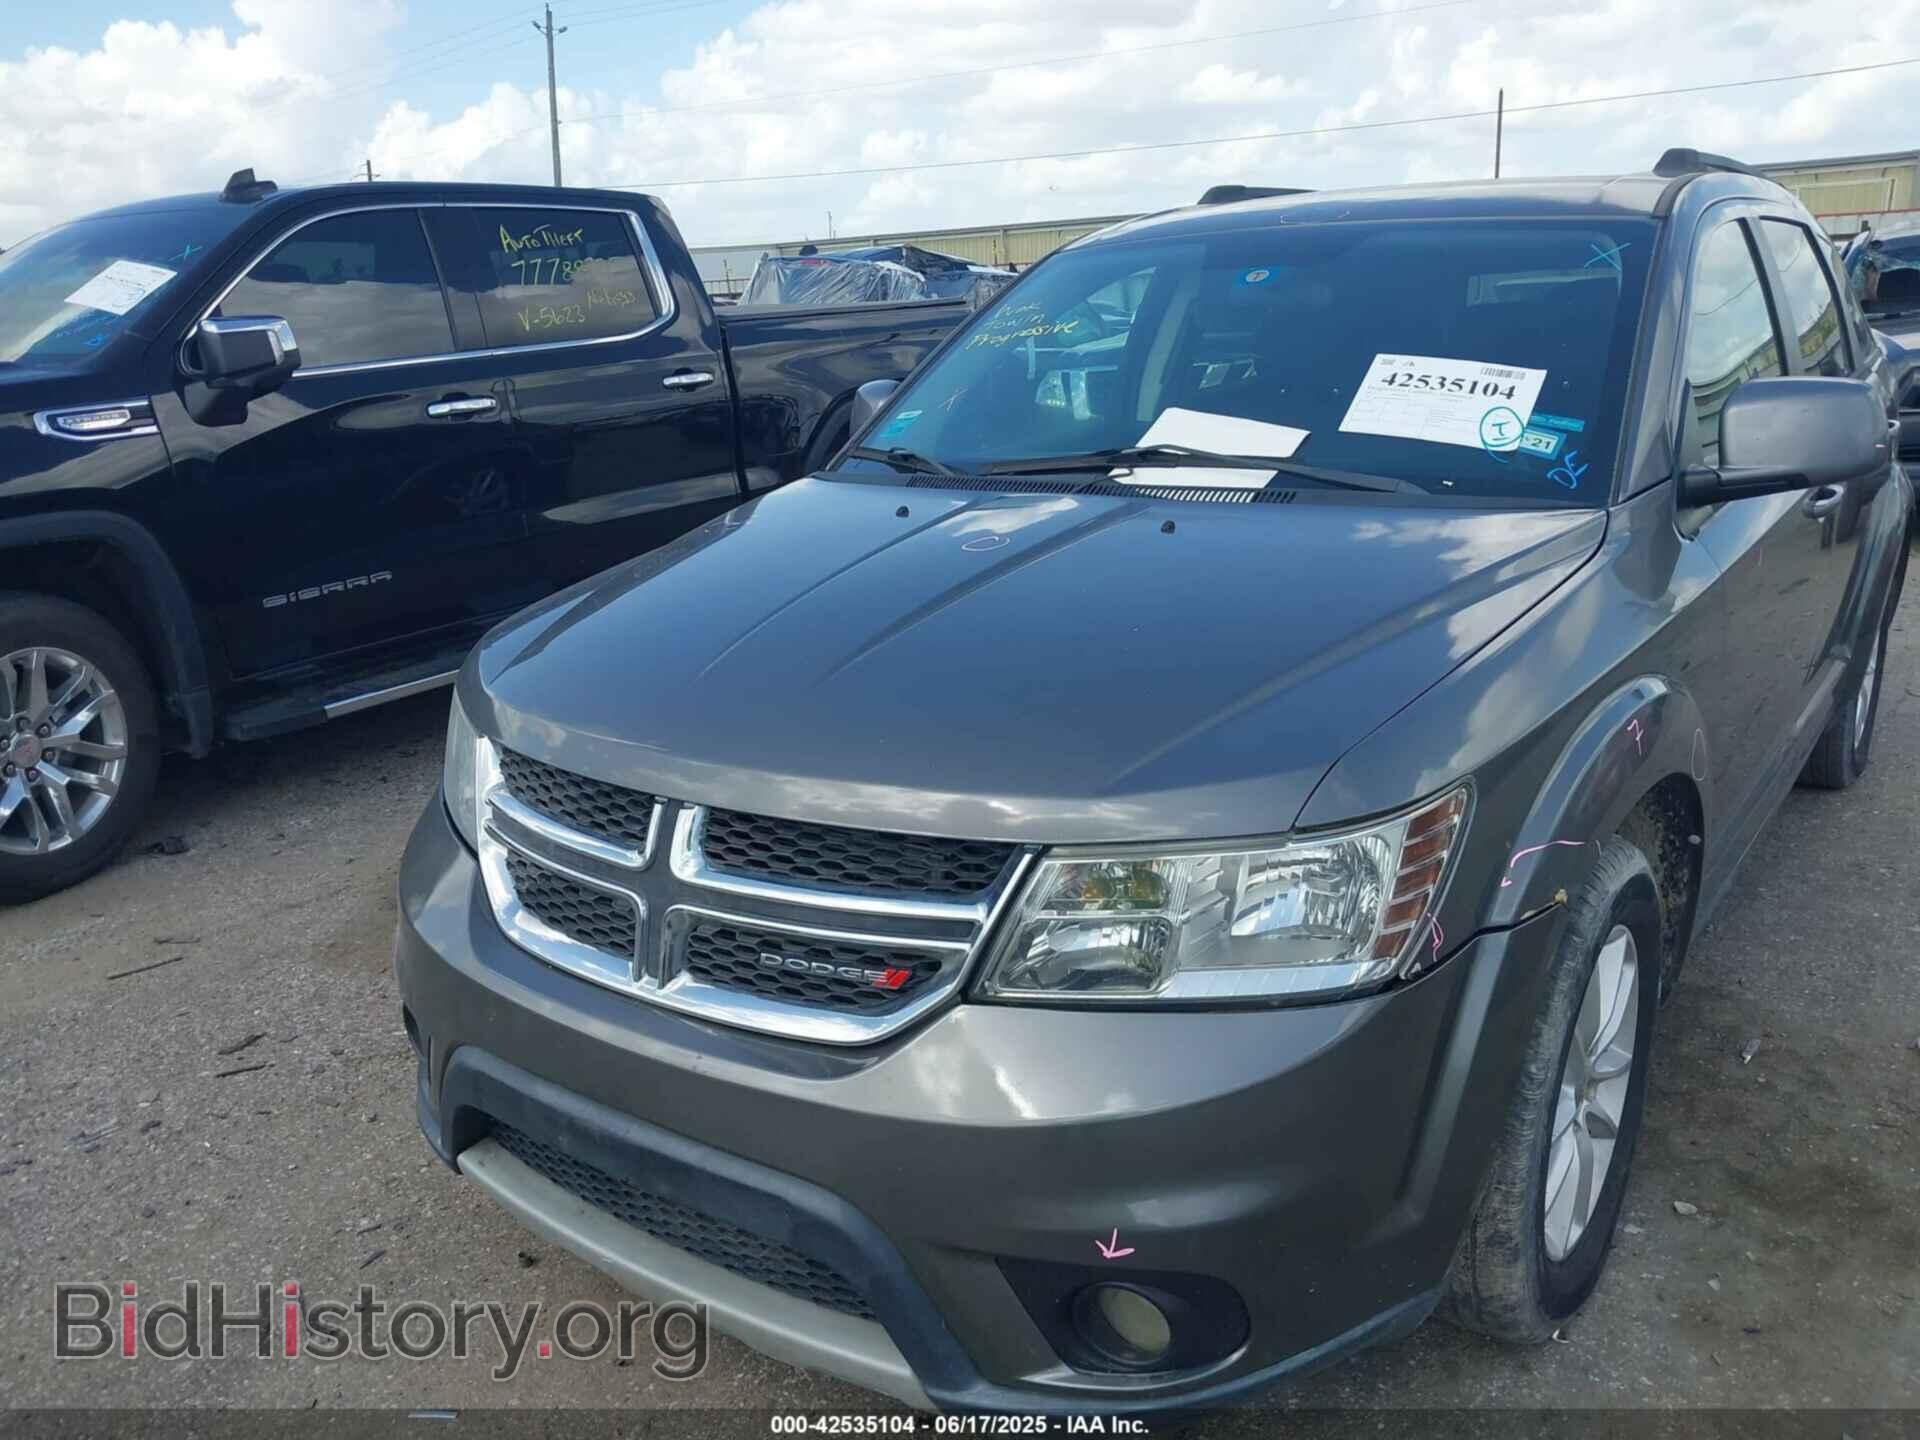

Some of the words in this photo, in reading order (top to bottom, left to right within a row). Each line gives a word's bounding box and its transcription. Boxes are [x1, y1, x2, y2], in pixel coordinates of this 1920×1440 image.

[1381, 371, 1517, 400] 42535104
[262, 570, 393, 608] SIERRA
[760, 952, 890, 984] DODGE
